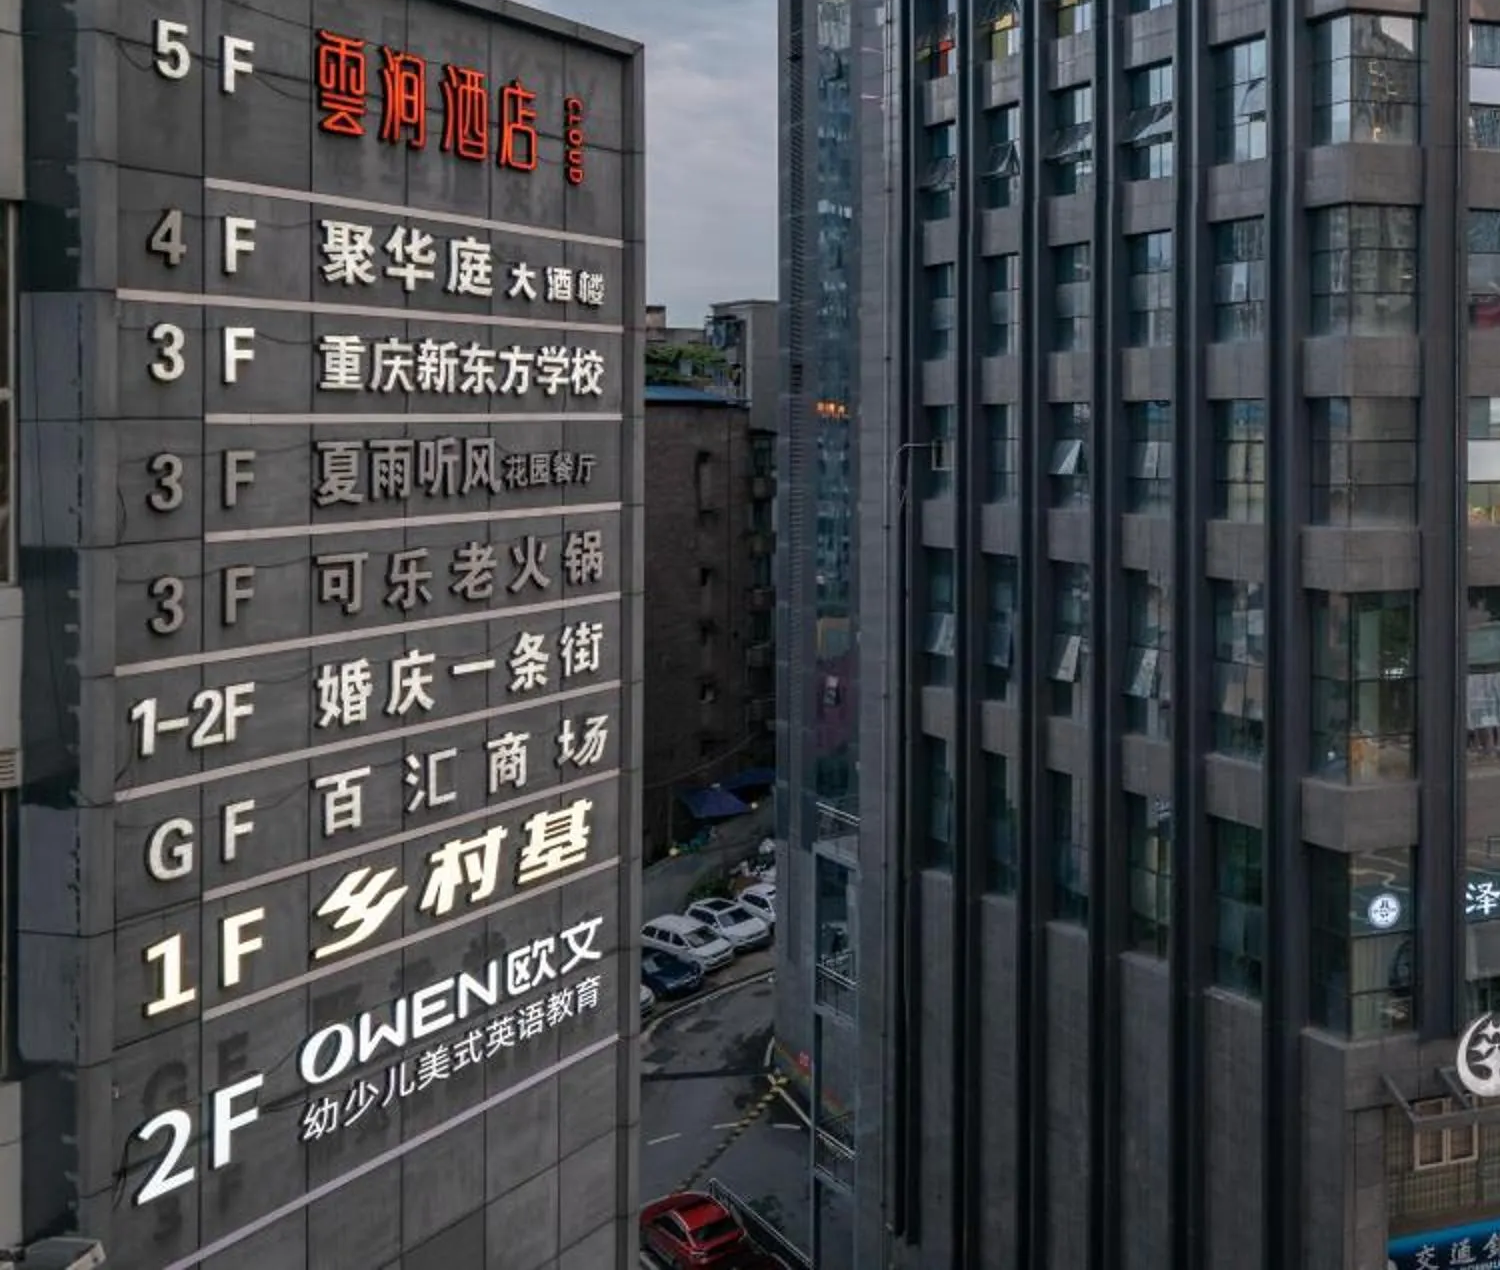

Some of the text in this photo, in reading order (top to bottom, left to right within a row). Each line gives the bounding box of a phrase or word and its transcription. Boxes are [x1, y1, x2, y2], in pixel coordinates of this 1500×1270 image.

[564, 96, 585, 186] CLOUD
[319, 334, 605, 397] 重庆新东方学校
[317, 529, 606, 614] 可乐老火锅
[131, 621, 604, 758] 1-2F 婚庆一条街
[315, 714, 609, 837] 百汇商场
[314, 798, 594, 961] 乡村基
[302, 974, 603, 1142] 幼少儿美式英语教育
[135, 1072, 266, 1207] 2F
